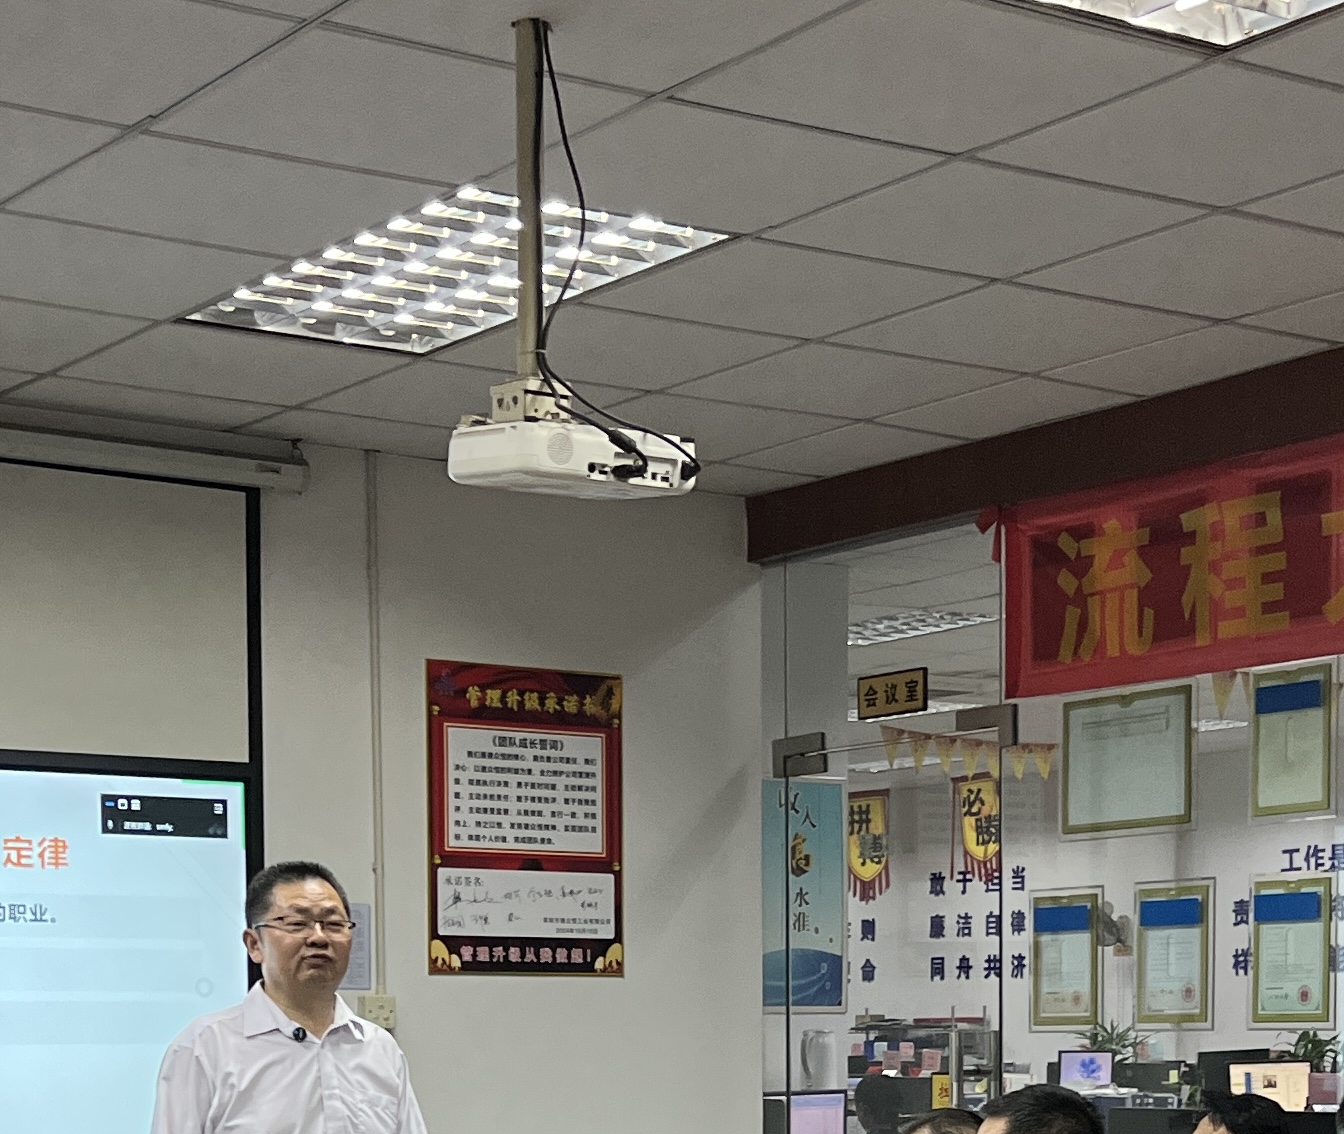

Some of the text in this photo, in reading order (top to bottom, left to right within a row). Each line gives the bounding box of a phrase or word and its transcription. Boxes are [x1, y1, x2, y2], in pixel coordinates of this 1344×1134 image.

[863, 678, 920, 708] 会议室
[928, 910, 1027, 939] 廉洁自律
[928, 953, 1027, 982] 同舟共济
